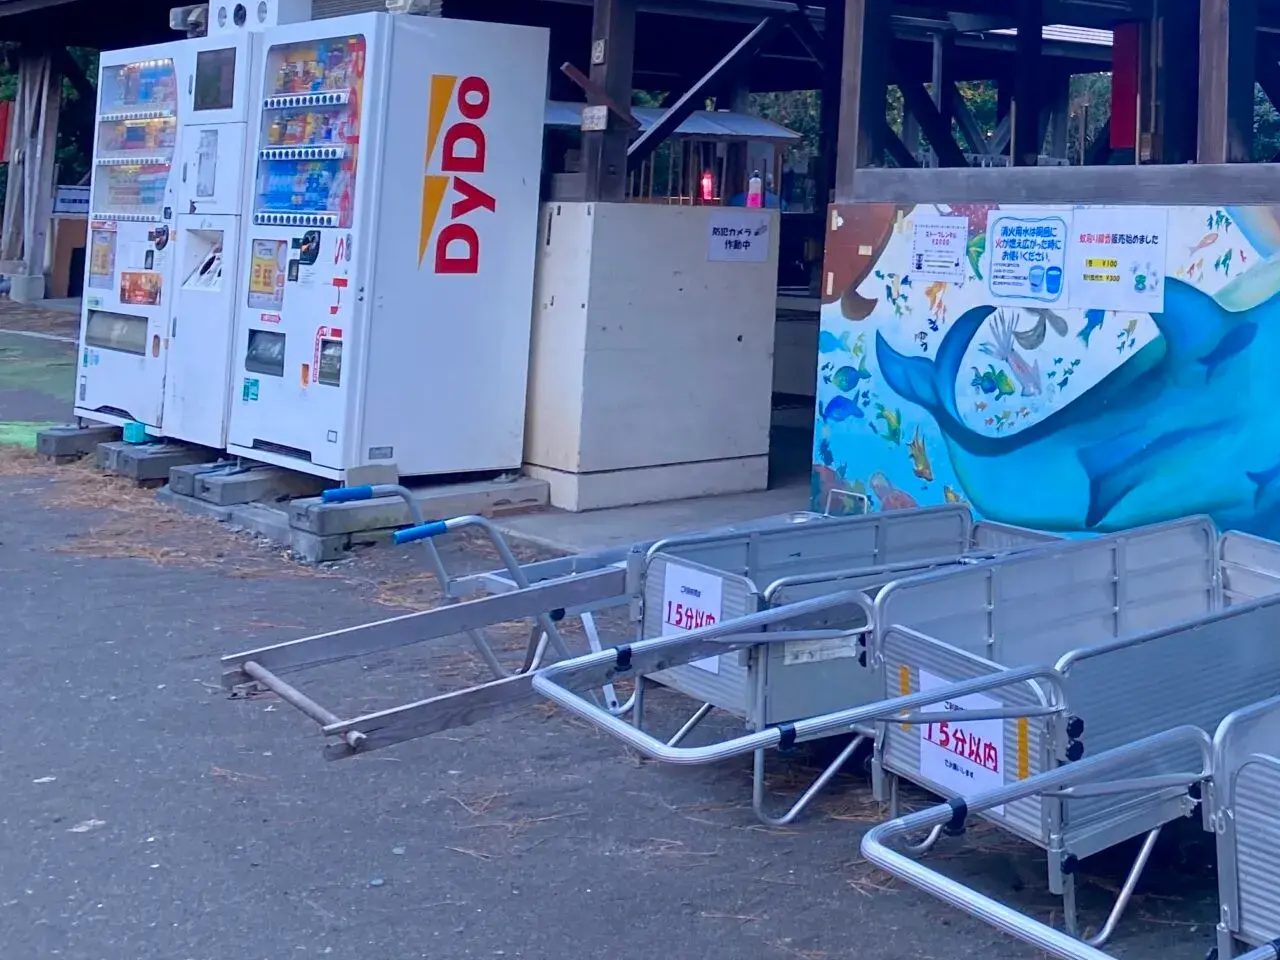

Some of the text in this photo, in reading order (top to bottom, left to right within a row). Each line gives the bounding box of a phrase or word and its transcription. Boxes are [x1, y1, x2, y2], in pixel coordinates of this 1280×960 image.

[711, 226, 752, 237] 防犯カメラ
[724, 239, 751, 250] 作動中
[927, 721, 998, 772] 15分以内
